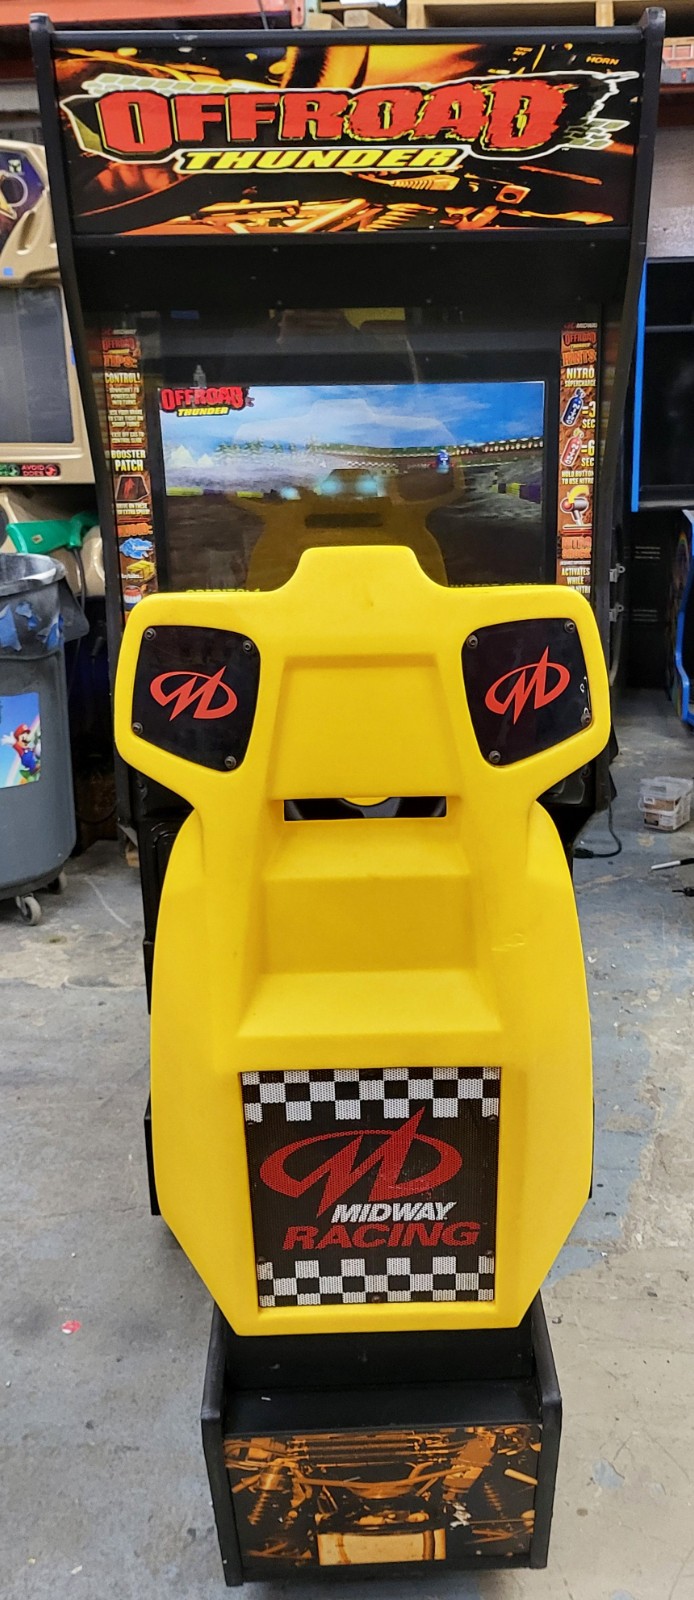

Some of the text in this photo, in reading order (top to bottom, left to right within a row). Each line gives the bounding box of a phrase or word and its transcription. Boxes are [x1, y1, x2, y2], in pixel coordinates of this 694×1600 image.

[586, 56, 620, 65] HORN
[97, 80, 568, 154] OFFROAD
[185, 148, 458, 169] THUNDER
[566, 368, 595, 379] NITRO
[161, 386, 244, 411] OFFROAD
[177, 407, 229, 417] THUNDER
[582, 419, 596, 428] SEC
[111, 450, 146, 459] BOOSTER
[115, 460, 144, 472] PATCH
[581, 457, 595, 467] SEC
[567, 576, 584, 585] WHILE
[331, 1202, 457, 1223] MIDWAY
[282, 1222, 481, 1250] RACING
